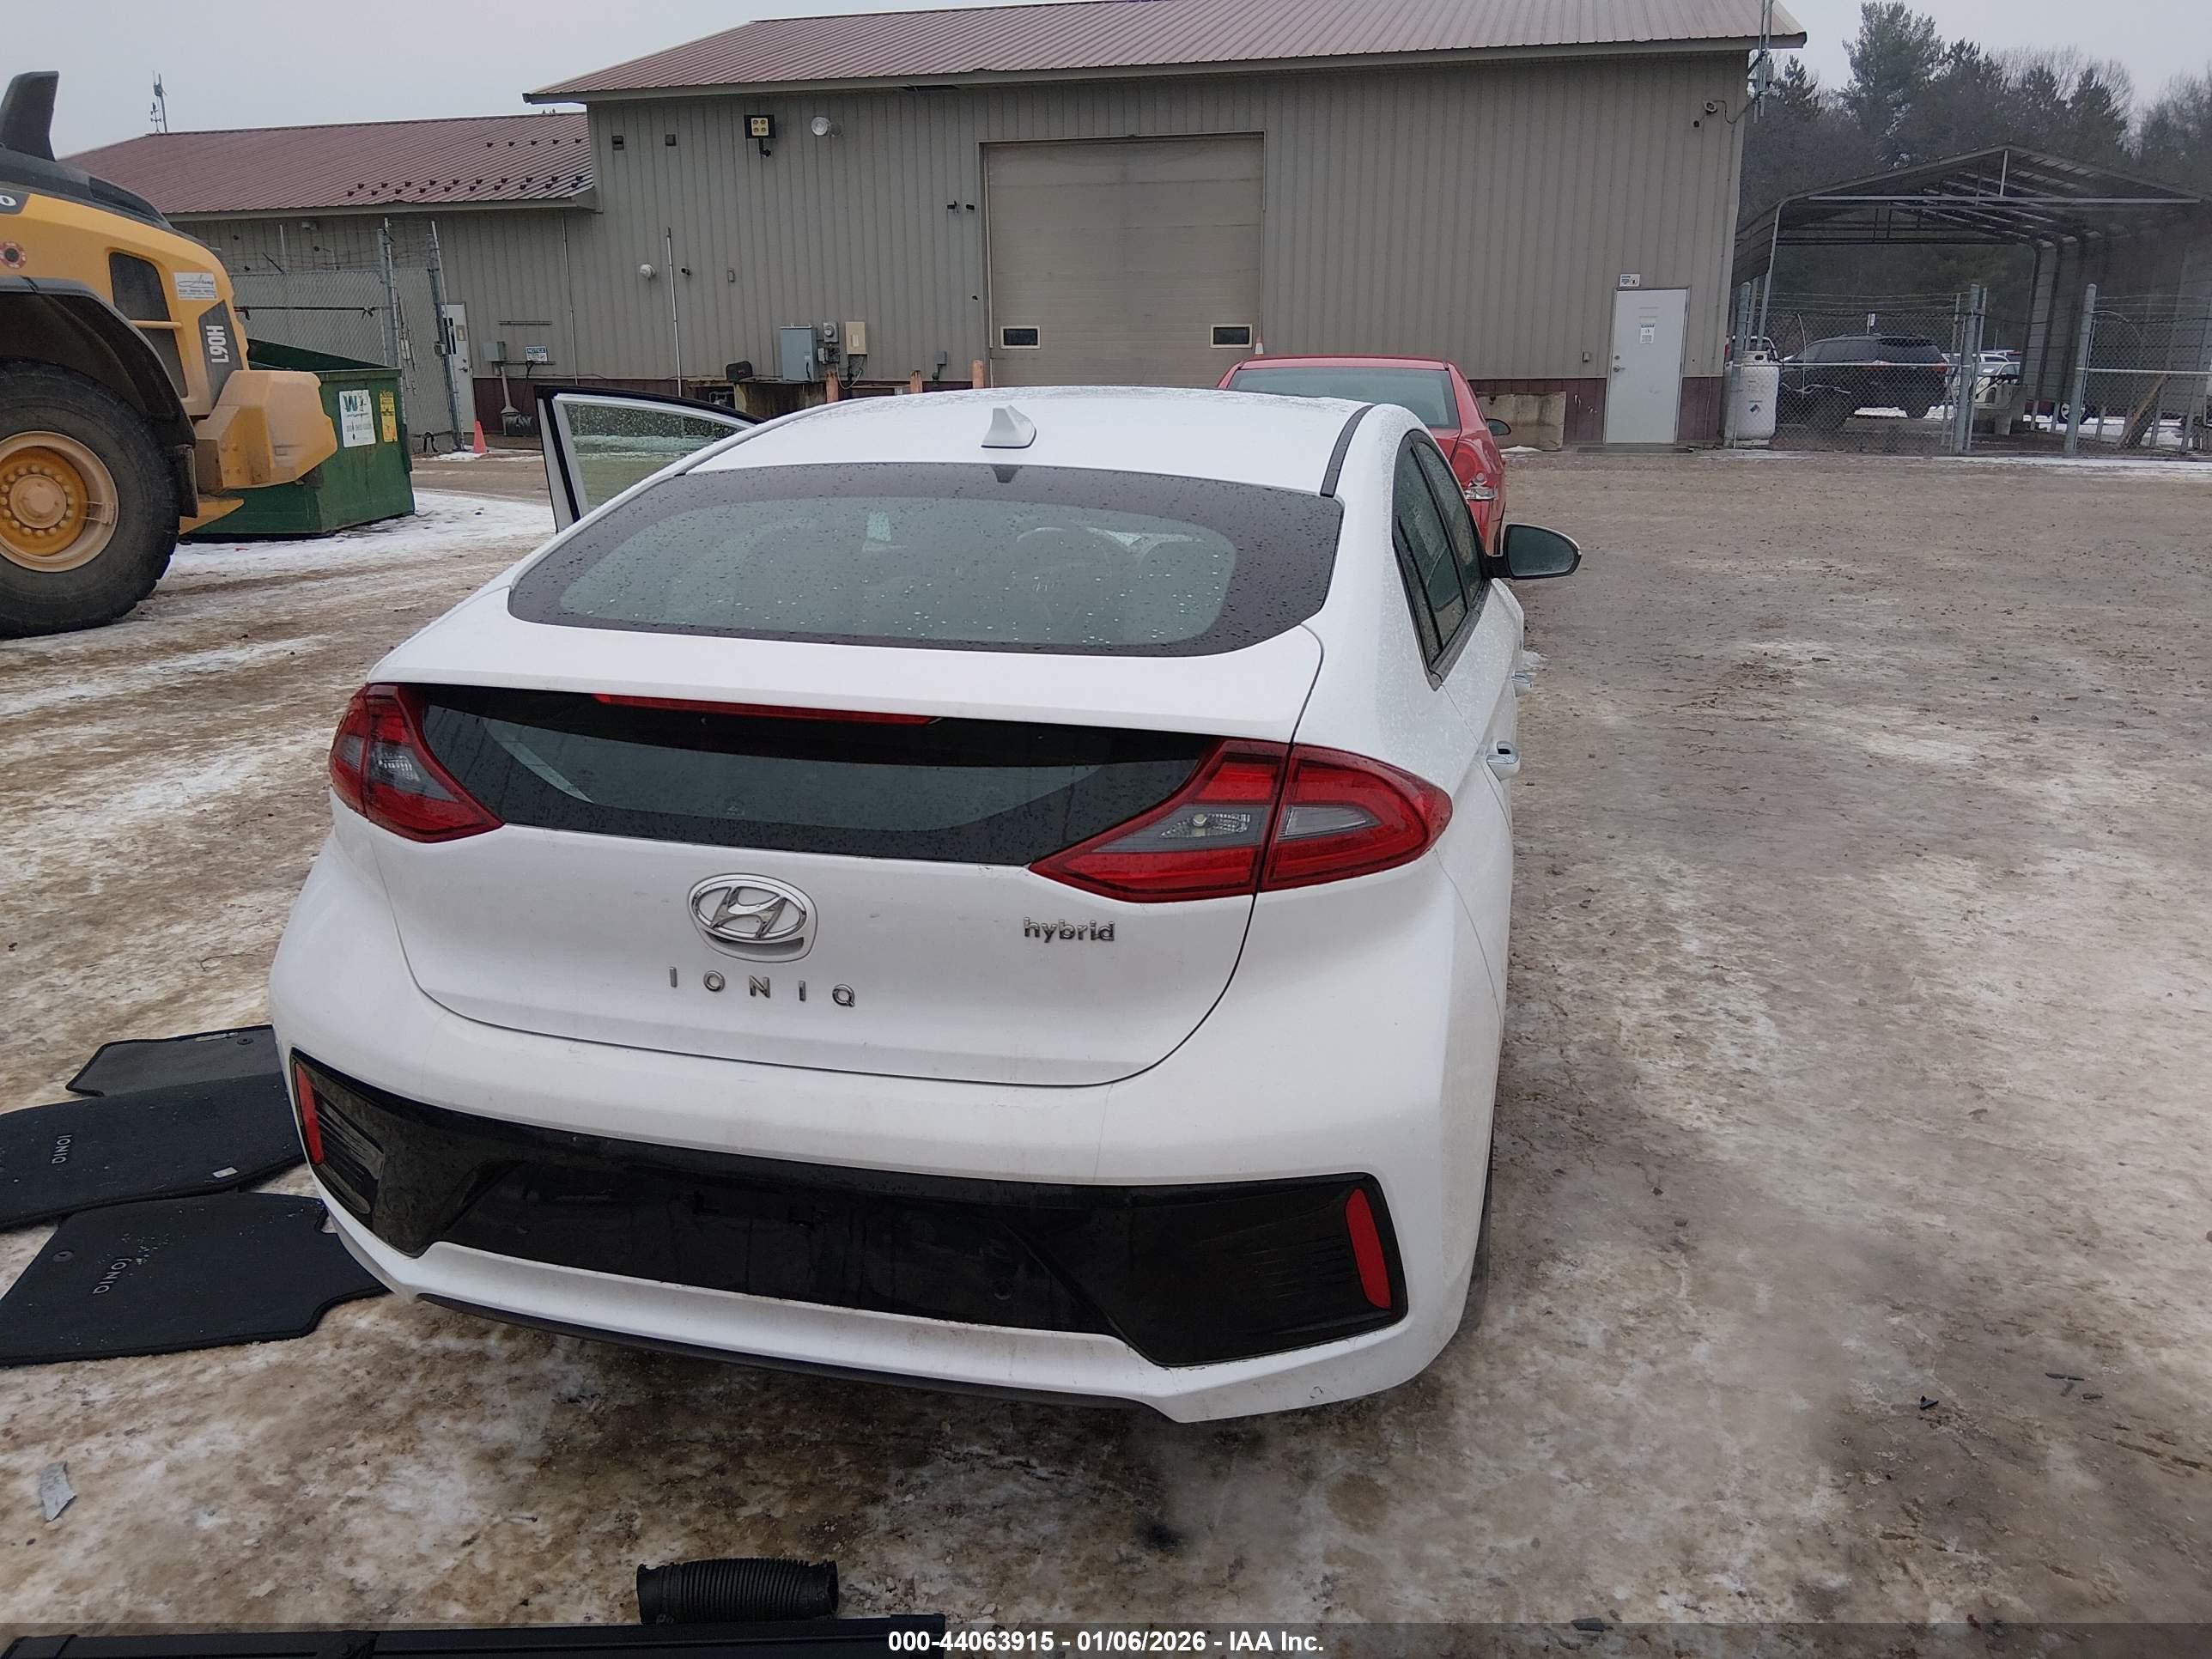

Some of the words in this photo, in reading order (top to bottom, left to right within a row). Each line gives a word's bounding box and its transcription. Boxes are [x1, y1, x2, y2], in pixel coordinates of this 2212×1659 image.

[206, 325, 229, 363] L90H
[1024, 917, 1115, 943] hybrid
[669, 966, 855, 1007] IONIQ
[52, 1134, 72, 1164] IONIQ
[92, 1258, 133, 1294] IONIQ
